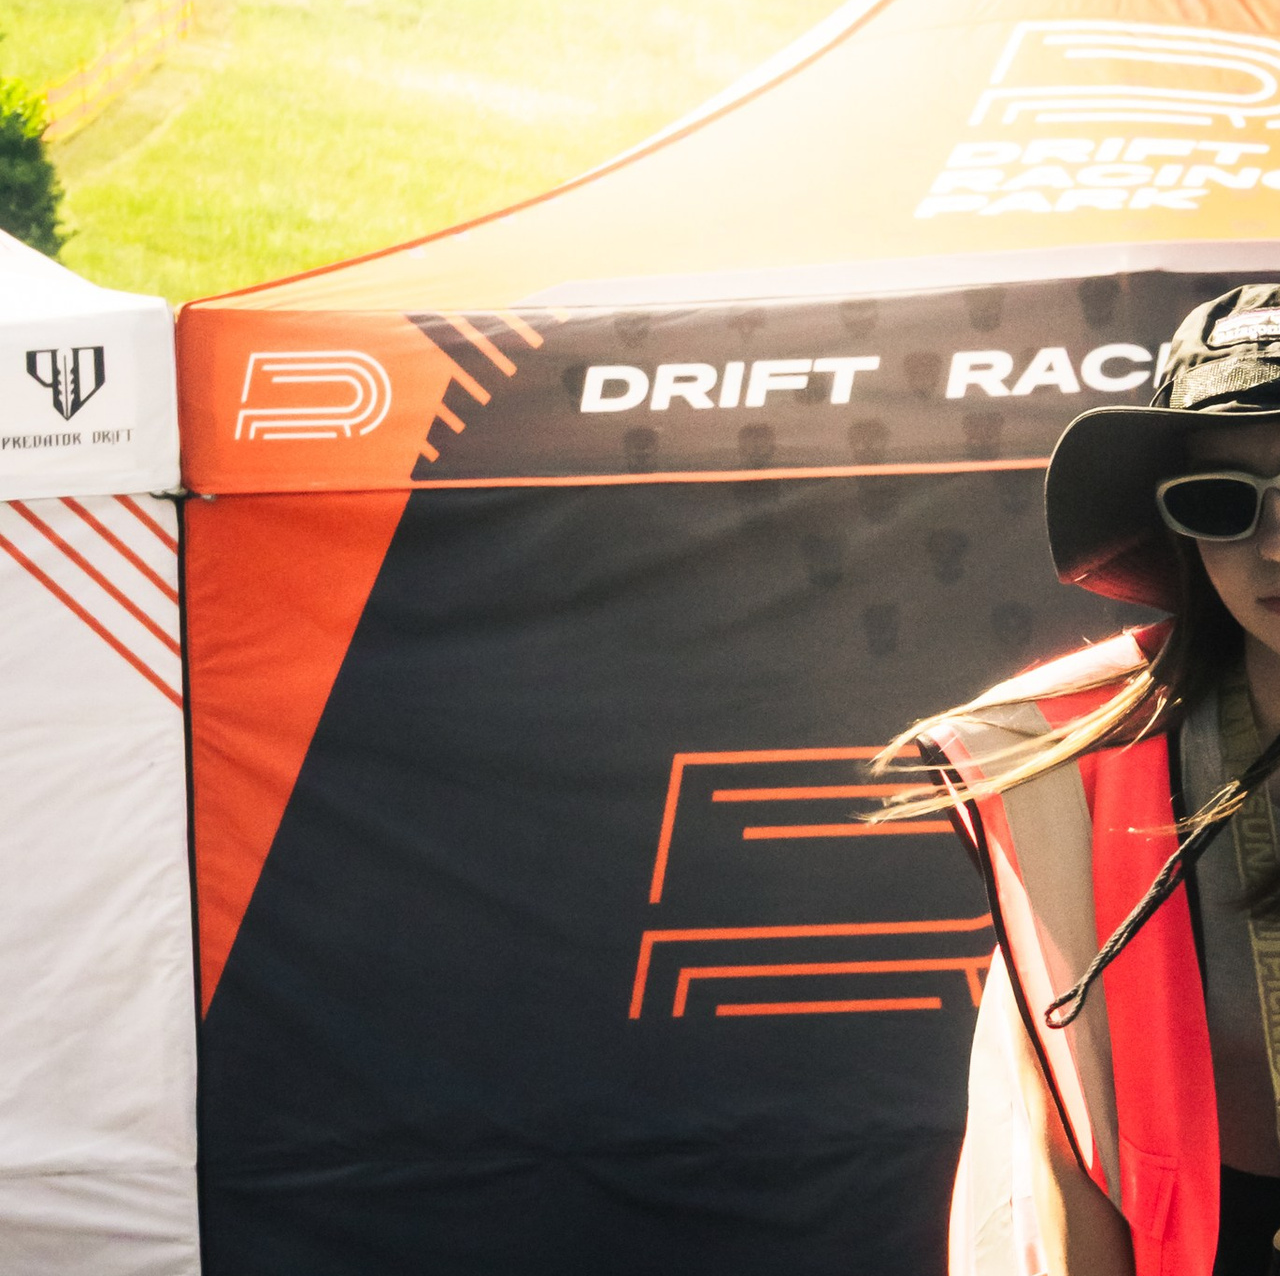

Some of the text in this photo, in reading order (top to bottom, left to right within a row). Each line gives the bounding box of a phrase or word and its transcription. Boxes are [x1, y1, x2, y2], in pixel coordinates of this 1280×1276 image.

[945, 137, 1271, 167] DRIFT
[913, 187, 1210, 219] PARK
[580, 355, 881, 413] DRIFT
[1, 428, 134, 450] PREDATOR DRIFT
